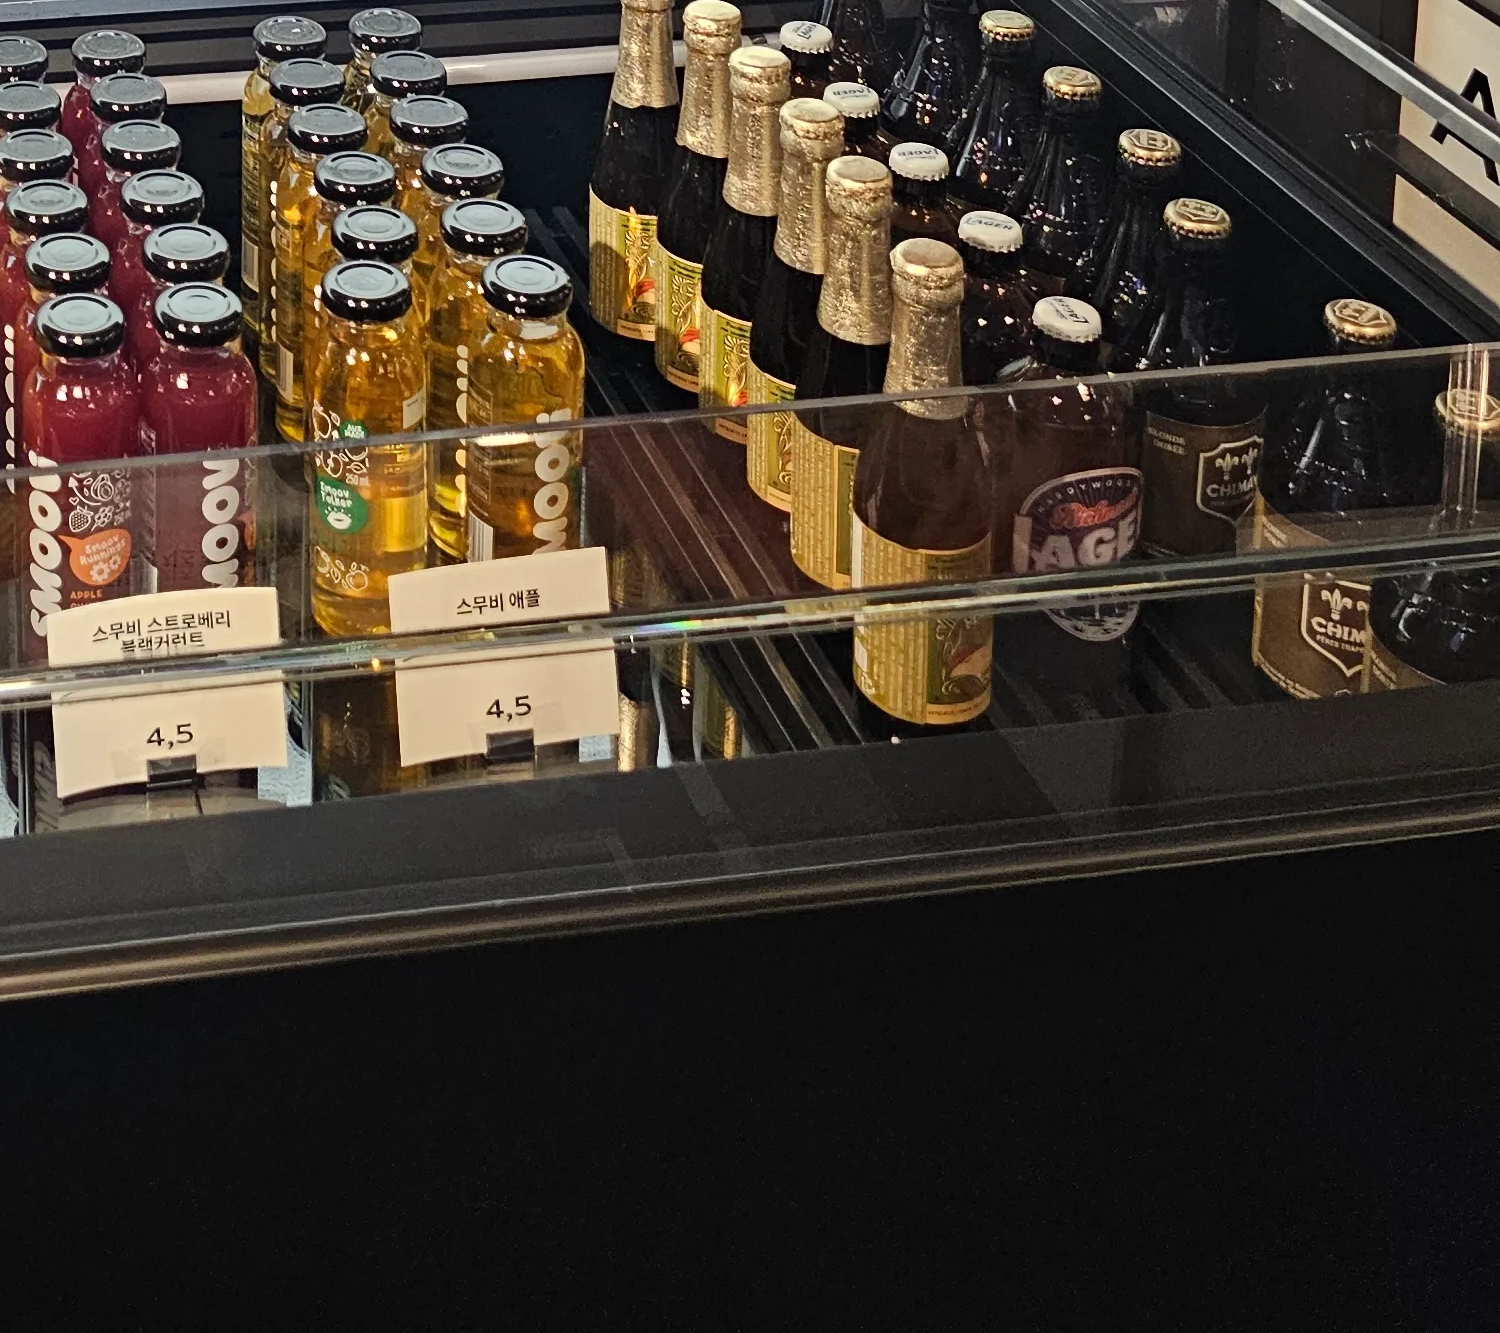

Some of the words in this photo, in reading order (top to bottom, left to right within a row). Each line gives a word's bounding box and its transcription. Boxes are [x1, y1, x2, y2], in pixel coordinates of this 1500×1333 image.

[965, 216, 1014, 231] LAGER
[70, 589, 102, 599] APPLE
[456, 593, 504, 615] 스무비
[508, 587, 540, 610] 애플
[92, 618, 141, 643] 스무비
[147, 610, 231, 634] 스트로베리
[486, 695, 532, 722] 4,5
[146, 723, 194, 749] 4,5
